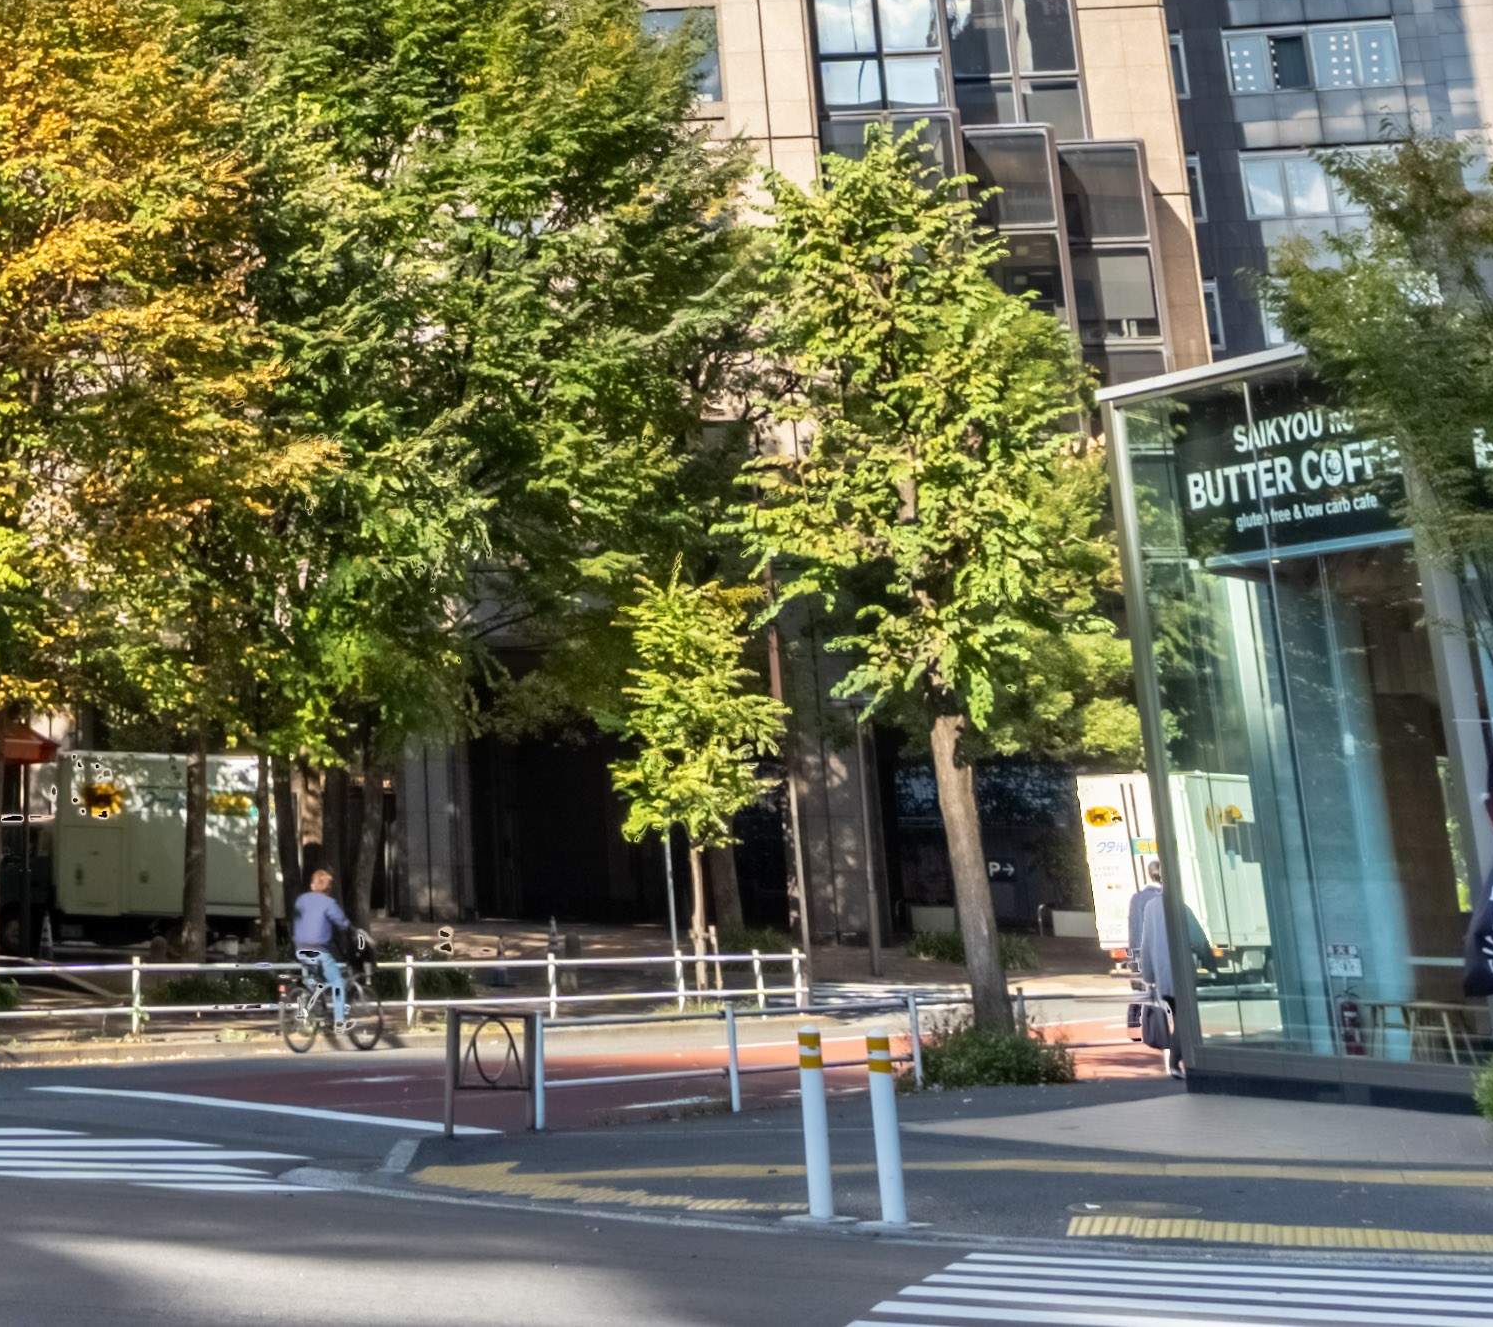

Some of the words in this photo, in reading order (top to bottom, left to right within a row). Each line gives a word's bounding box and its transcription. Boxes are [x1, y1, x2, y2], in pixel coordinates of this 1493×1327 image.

[1233, 410, 1324, 454] SAIKYOU
[1186, 455, 1297, 511] BUTTER
[1303, 499, 1324, 519] low
[1325, 496, 1351, 518] carb
[1352, 491, 1379, 512] cafe
[988, 861, 1001, 877] P
